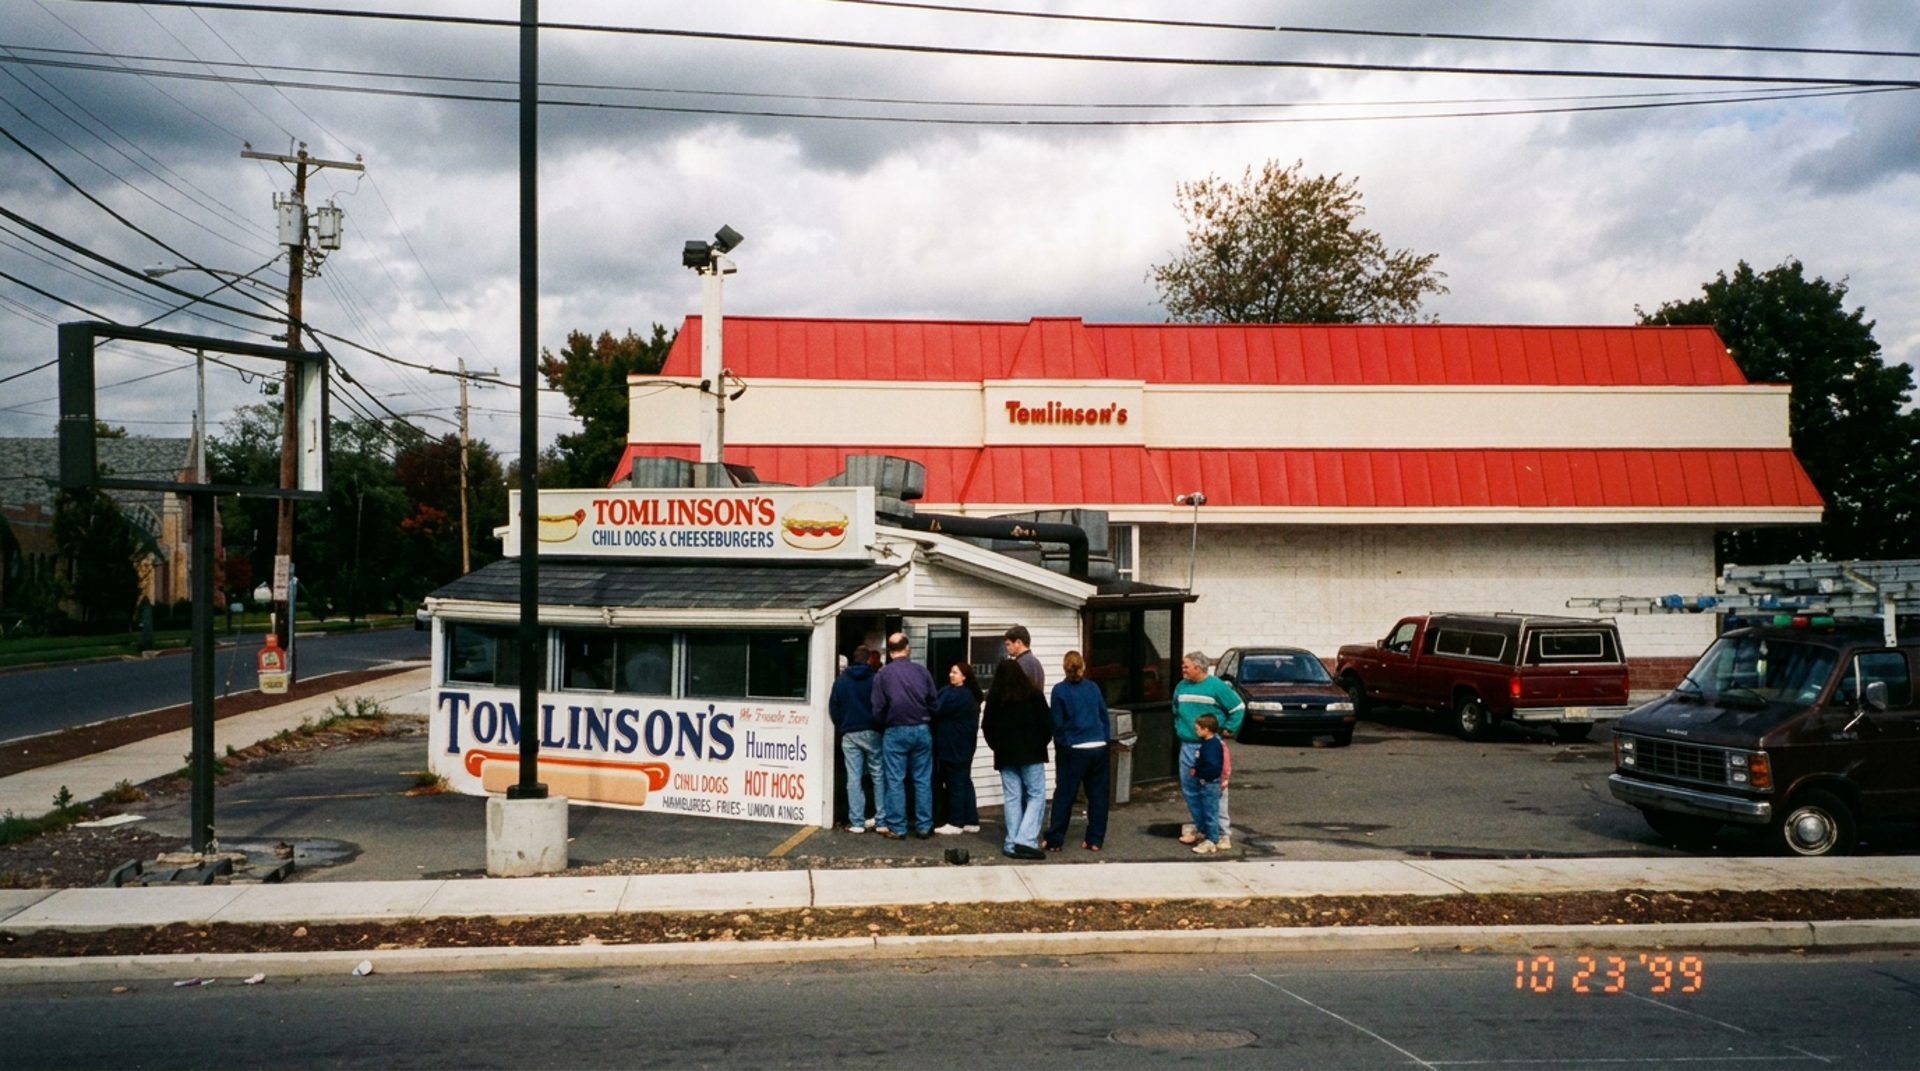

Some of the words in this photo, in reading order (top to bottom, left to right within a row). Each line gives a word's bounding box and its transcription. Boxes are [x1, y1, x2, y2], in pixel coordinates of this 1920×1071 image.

[1006, 401, 1128, 425] Tomlinson's
[592, 496, 775, 526] TOMLINSON'S
[592, 529, 621, 546] CHILI
[624, 530, 656, 547] DOGS
[659, 531, 667, 547] &
[669, 530, 774, 548] CHEESEBURGERS
[745, 730, 808, 762] Hummels
[701, 774, 729, 795] DOGS
[744, 770, 768, 798] HOT
[771, 772, 805, 801] HOGS
